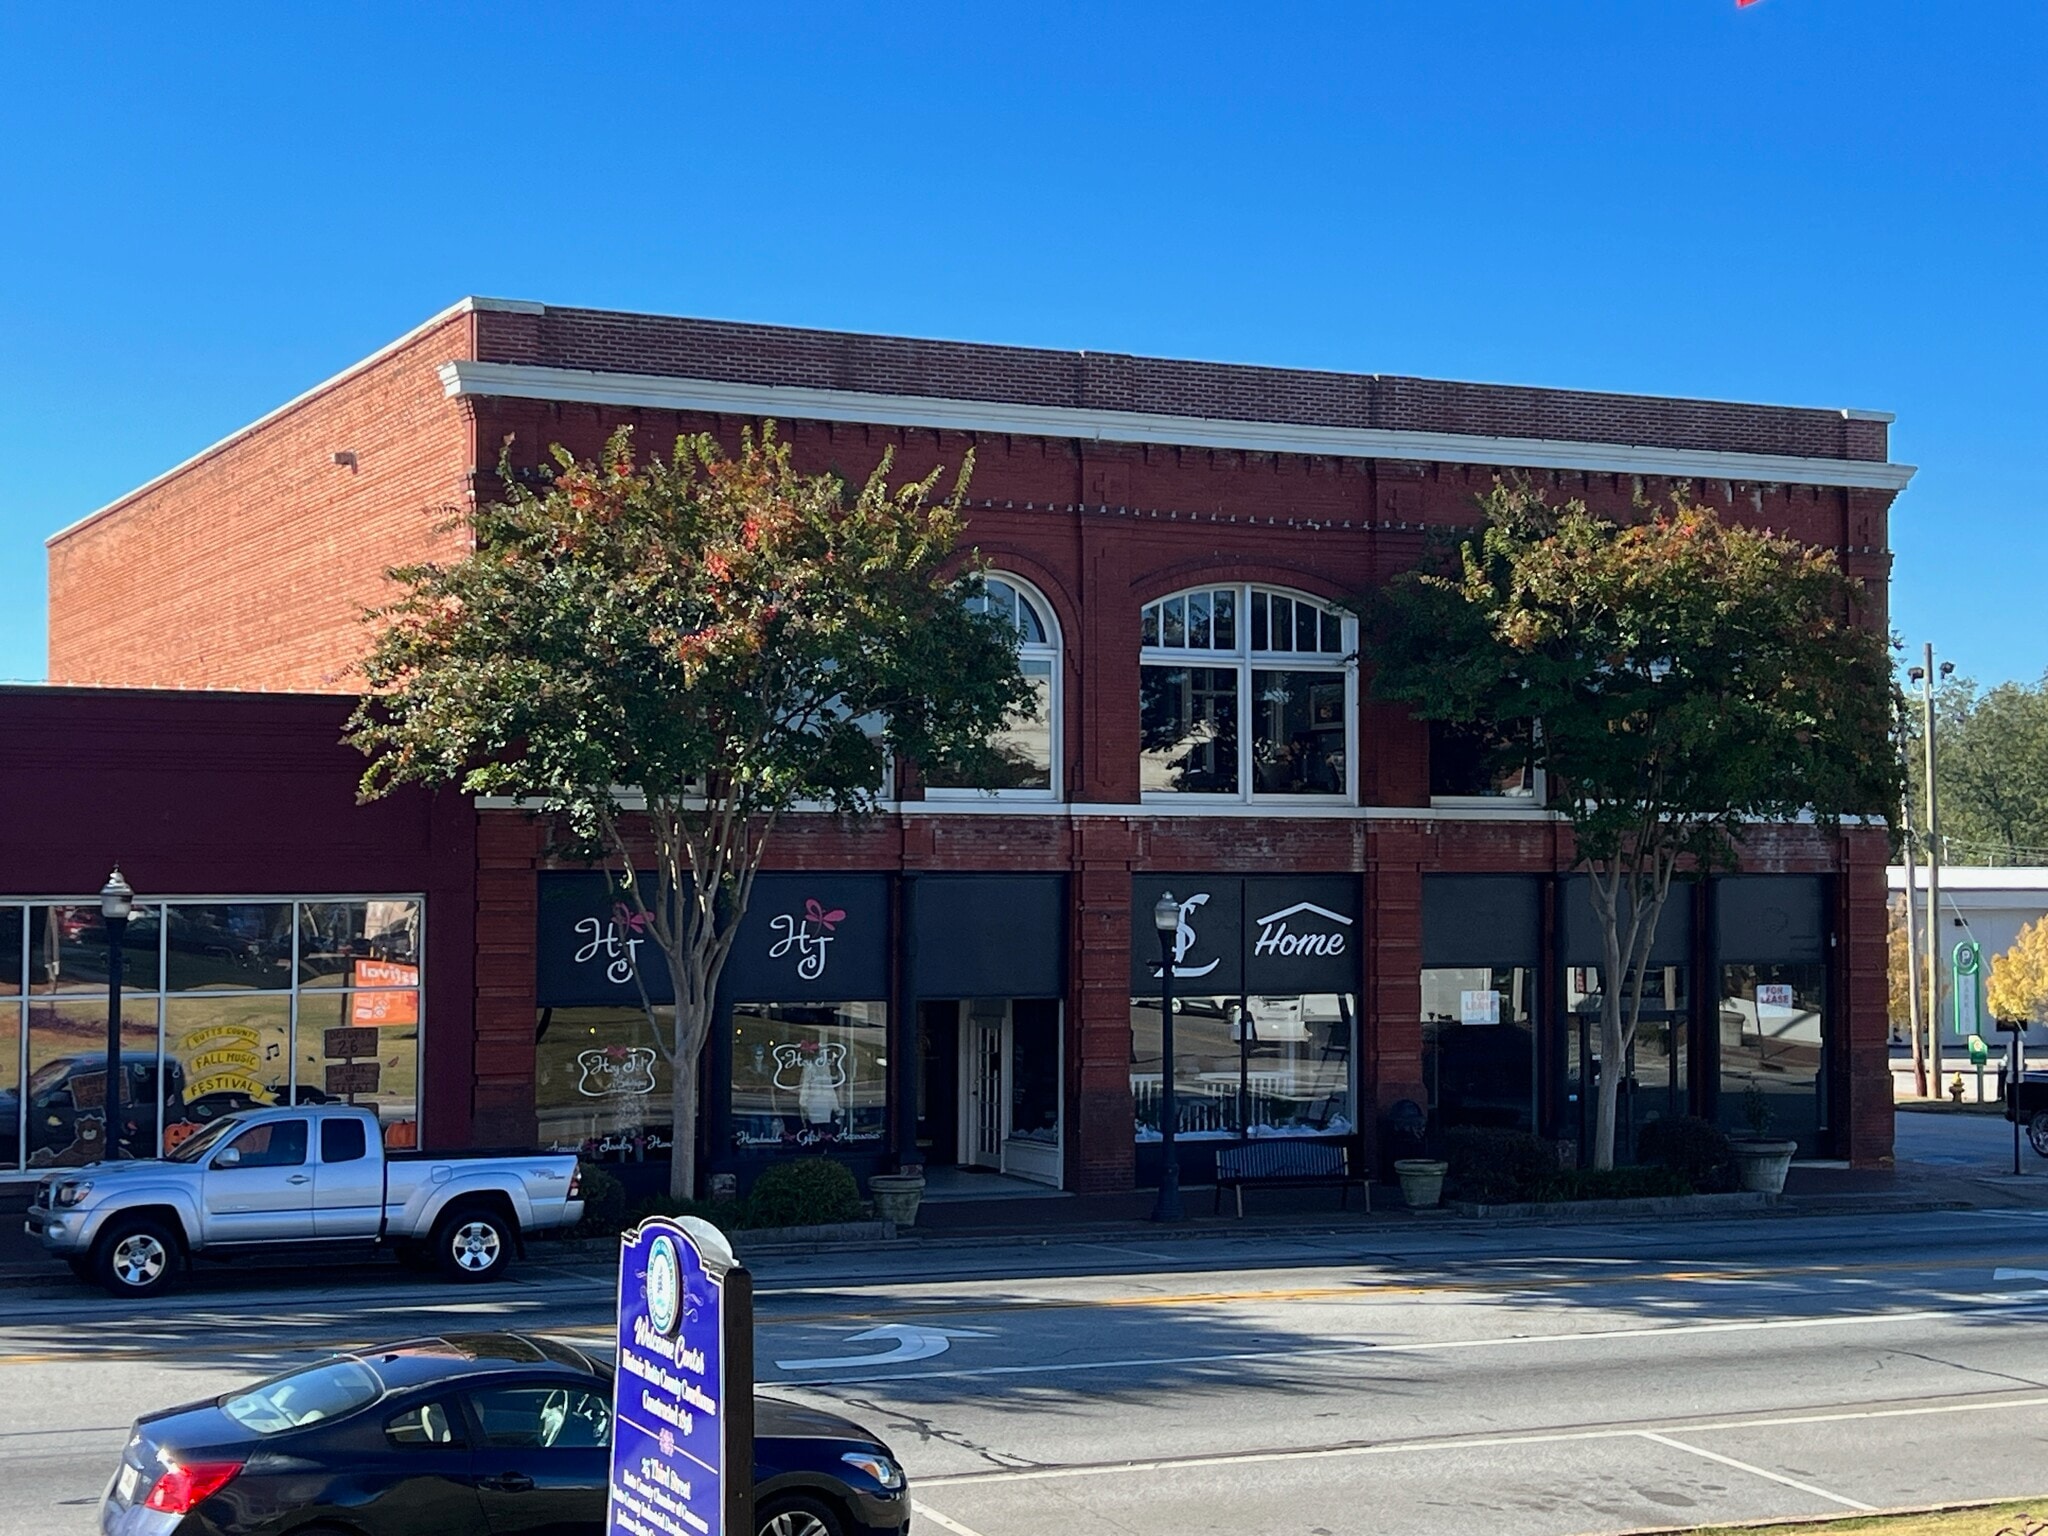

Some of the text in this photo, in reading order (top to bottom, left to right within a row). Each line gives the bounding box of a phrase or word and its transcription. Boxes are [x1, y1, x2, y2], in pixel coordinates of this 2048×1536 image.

[1254, 922, 1346, 956] Home
[1962, 950, 1970, 963] P
[1760, 994, 1789, 1004] LEASE
[1765, 986, 1784, 995] FOR
[192, 1027, 258, 1044] BUTTS COUNTY
[337, 1040, 359, 1055] 26
[195, 1052, 257, 1069] FALL MUSIC
[190, 1077, 254, 1097] FESTIVAL
[634, 1315, 704, 1375] Welcome Center
